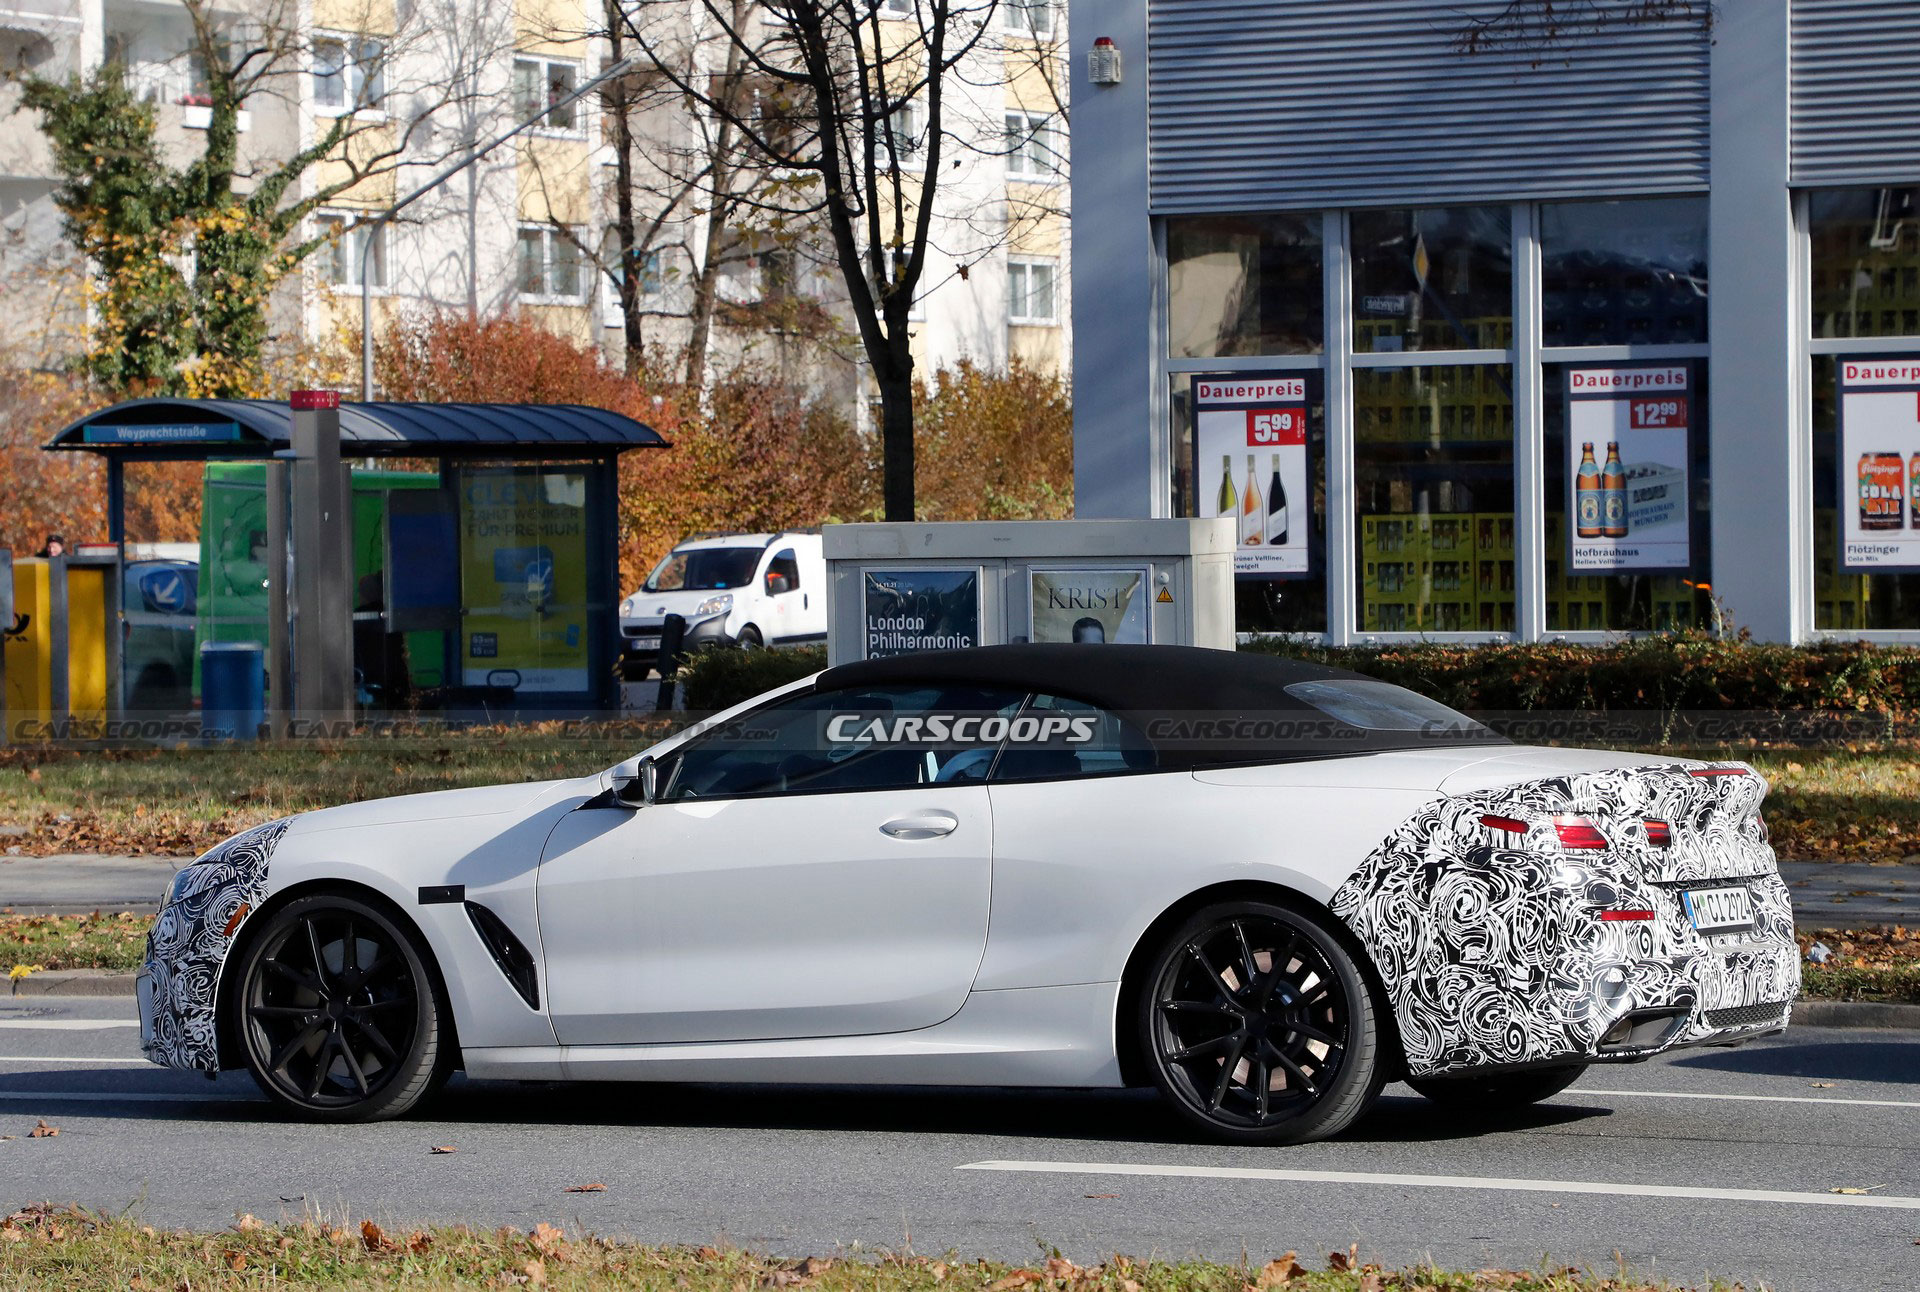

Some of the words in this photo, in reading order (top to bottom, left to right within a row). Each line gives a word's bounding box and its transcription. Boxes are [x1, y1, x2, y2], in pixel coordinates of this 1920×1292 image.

[1573, 369, 1685, 388] Dauerpreis
[1200, 382, 1304, 399] Dauerpreis
[1634, 402, 1678, 425] 12.99
[117, 426, 207, 440] Weyprechtstraße
[1254, 413, 1292, 442] 5.99
[1861, 485, 1902, 500] COLA
[1575, 548, 1640, 557] Hofbräuhaus
[1848, 545, 1900, 555] Flötzinger
[869, 614, 925, 631] London
[869, 632, 971, 649] Philharmonic
[1691, 896, 1705, 925] M
